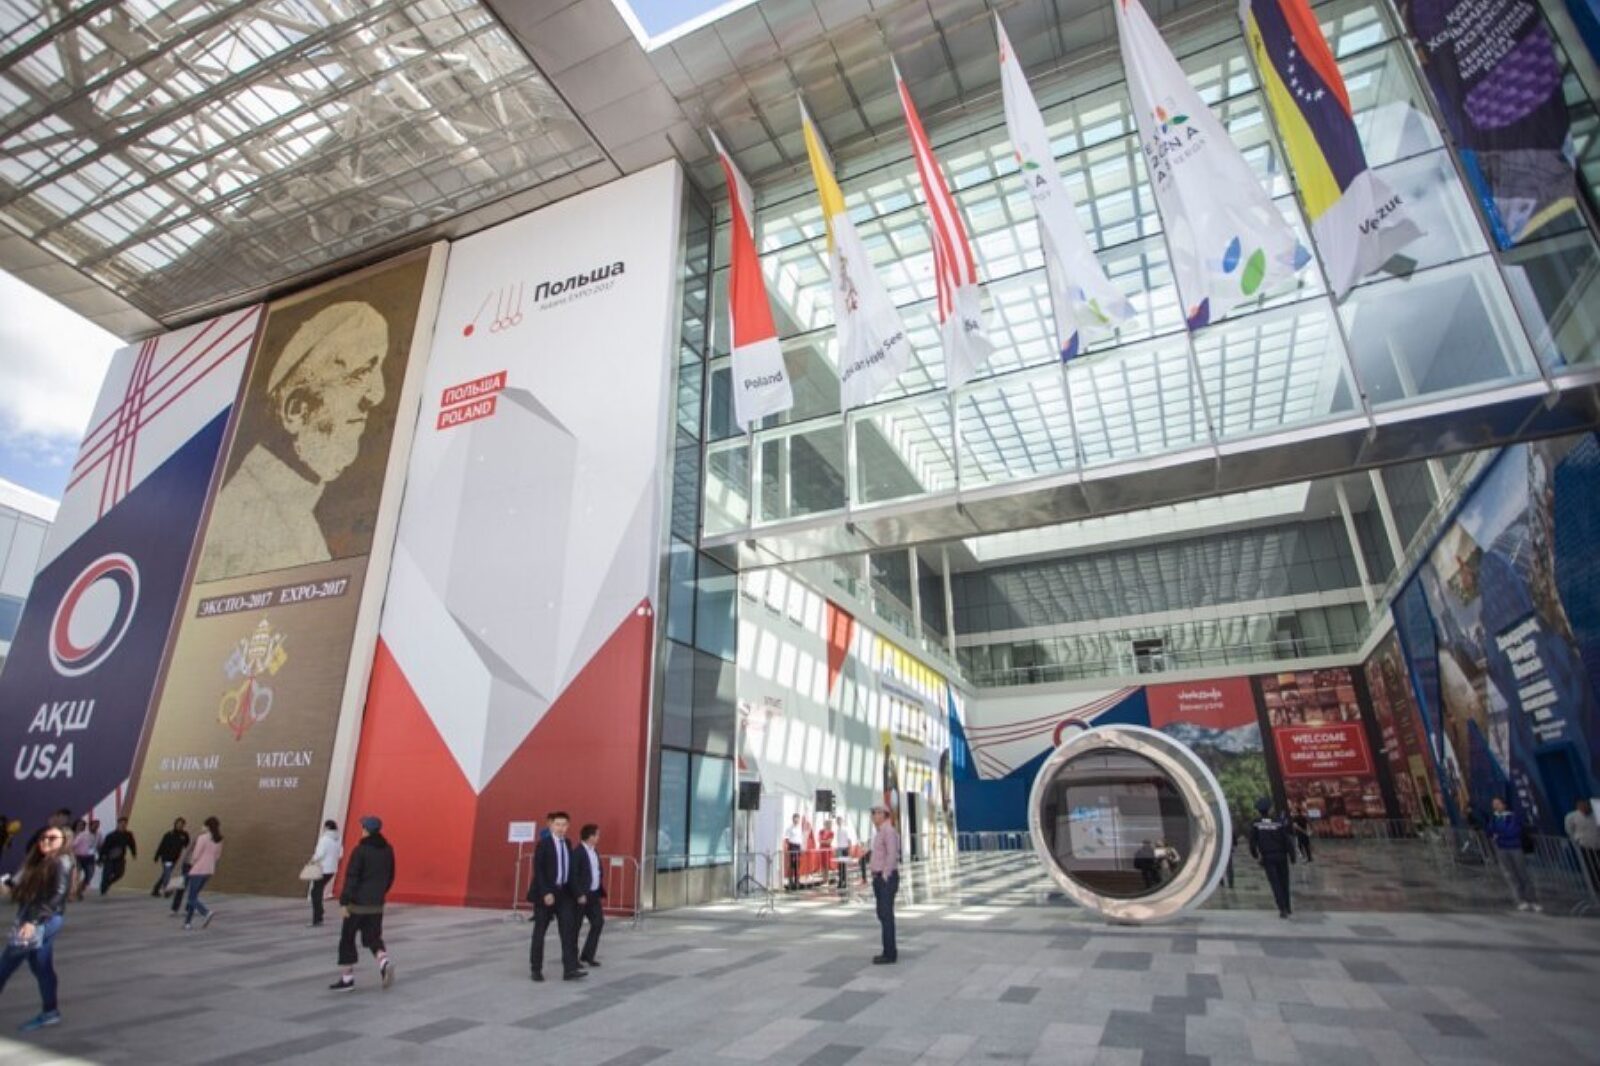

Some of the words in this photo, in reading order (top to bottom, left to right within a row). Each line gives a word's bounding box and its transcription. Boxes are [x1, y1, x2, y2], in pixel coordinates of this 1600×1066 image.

[534, 261, 625, 303] Польша
[445, 375, 501, 404] ПОЛЬША
[744, 370, 784, 391] Poland
[441, 401, 492, 427] POLAND
[200, 591, 273, 616] ЭКСПО-2017
[279, 579, 348, 603] EXPO-2017
[27, 699, 96, 738] АҚШ
[1291, 732, 1347, 744] WELCOME
[13, 742, 75, 781] USA
[256, 750, 314, 768] VATICAN
